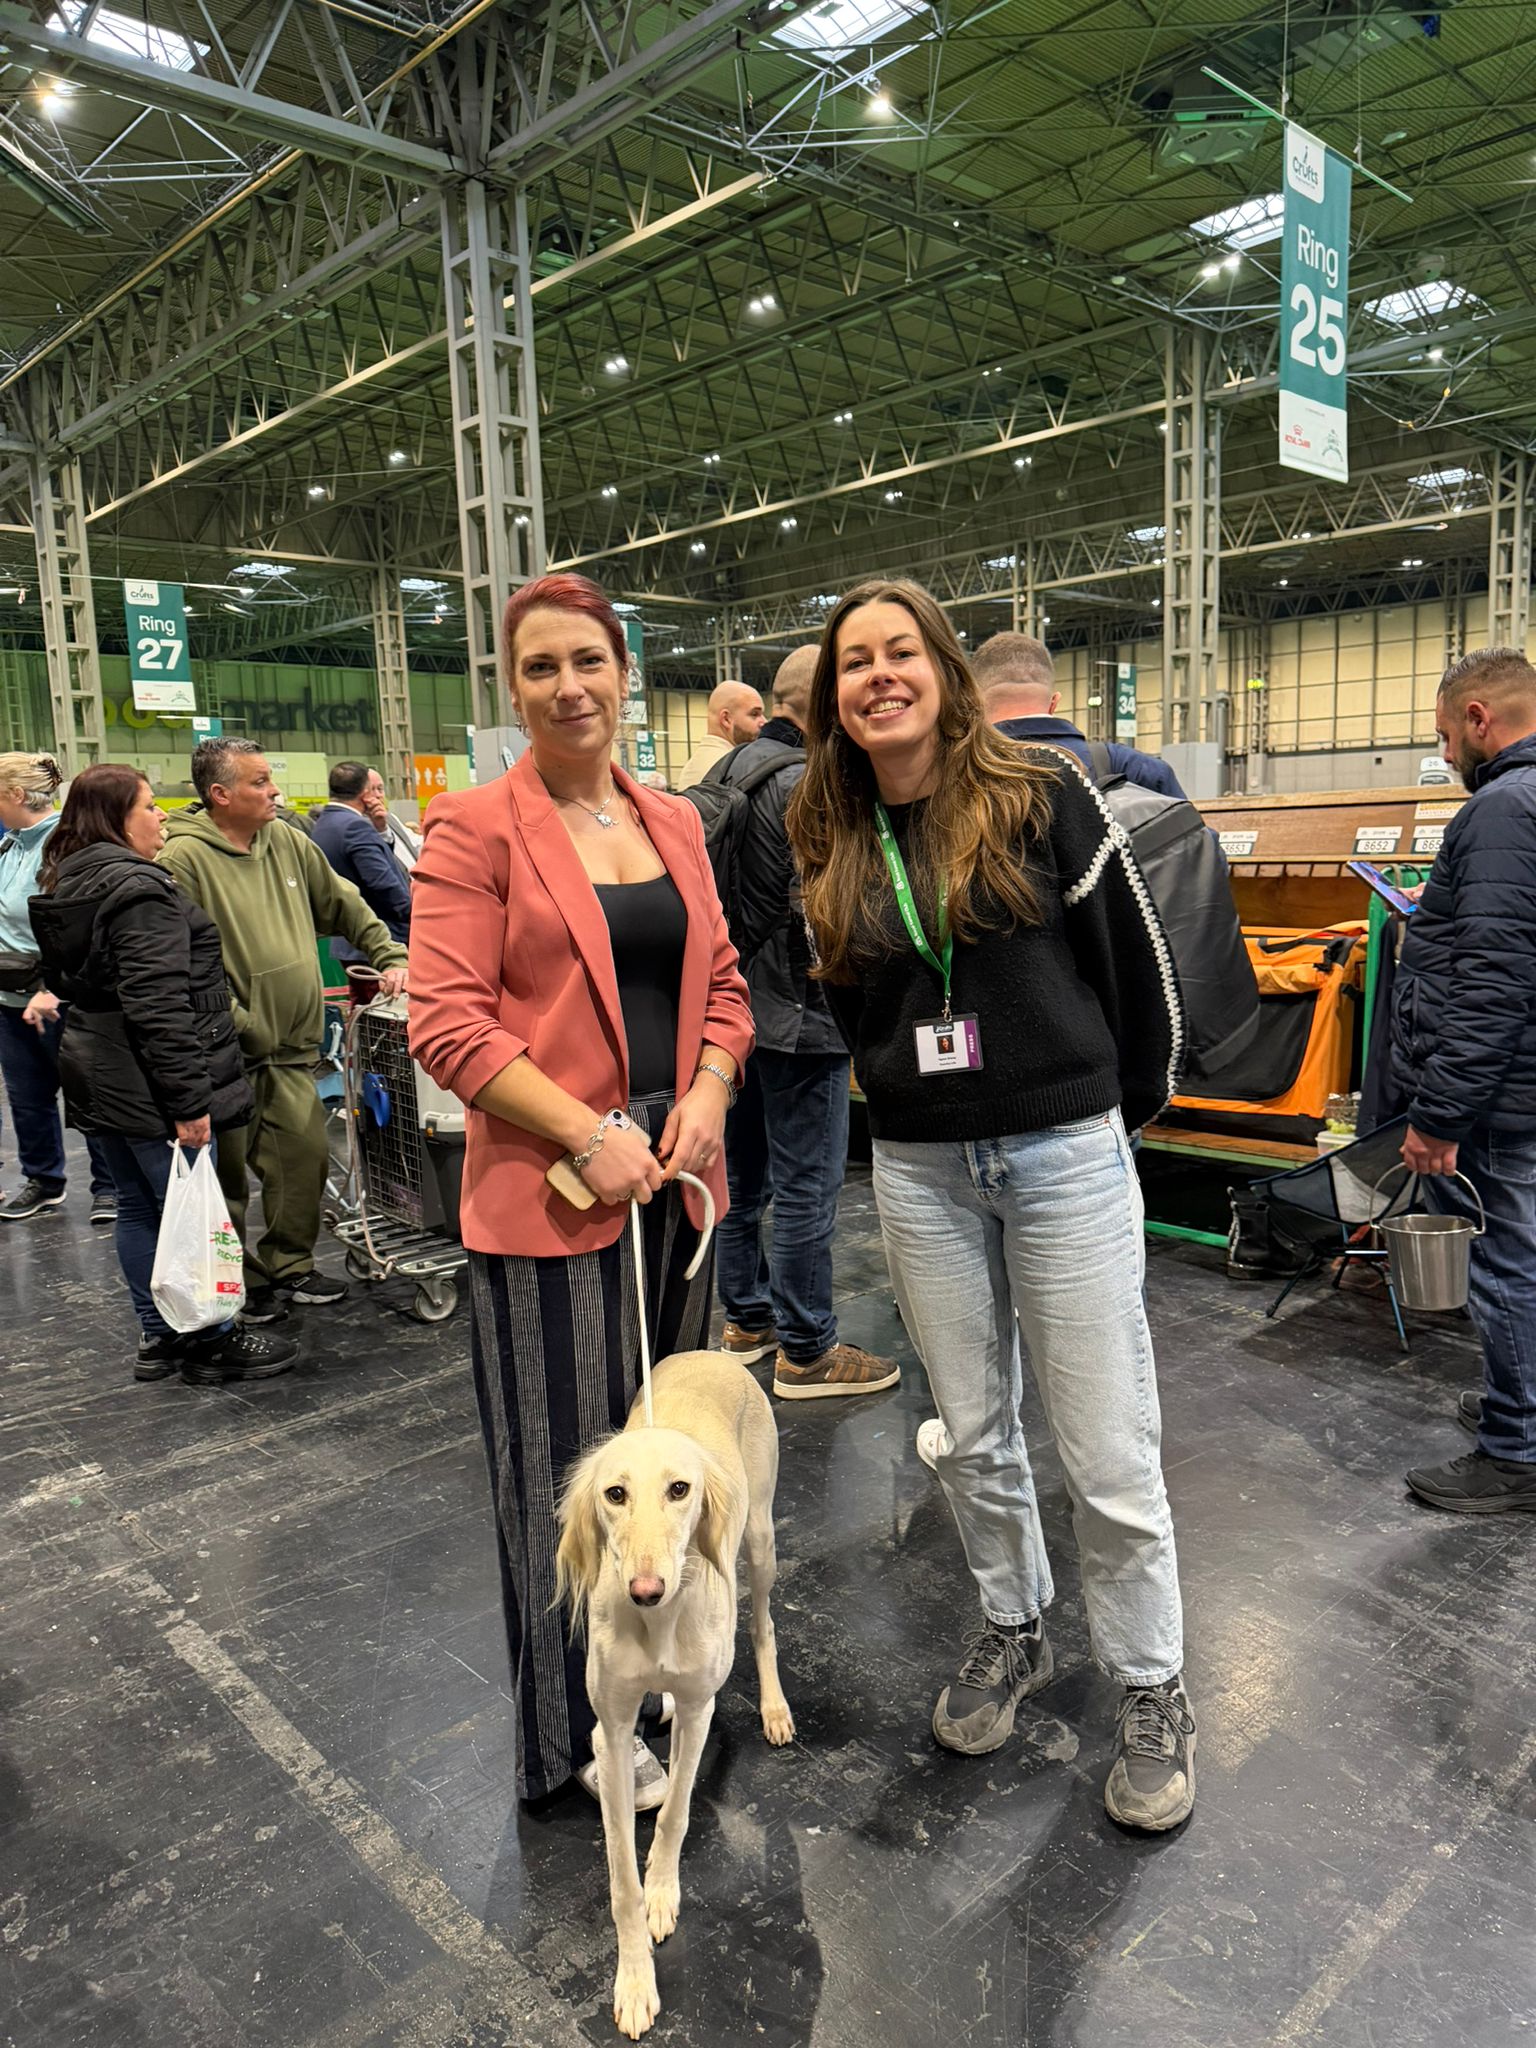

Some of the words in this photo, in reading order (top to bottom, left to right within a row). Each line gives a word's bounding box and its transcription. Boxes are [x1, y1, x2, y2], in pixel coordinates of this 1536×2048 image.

[1292, 156, 1318, 185] Crufts
[1297, 223, 1339, 289] Ring
[1290, 283, 1346, 376] 25
[139, 615, 175, 636] Ring
[136, 637, 183, 670] 27
[222, 687, 376, 734] market
[1119, 695, 1136, 714] 34
[640, 753, 655, 767] 32
[1364, 841, 1389, 851] 8652
[1422, 840, 1441, 850] 865
